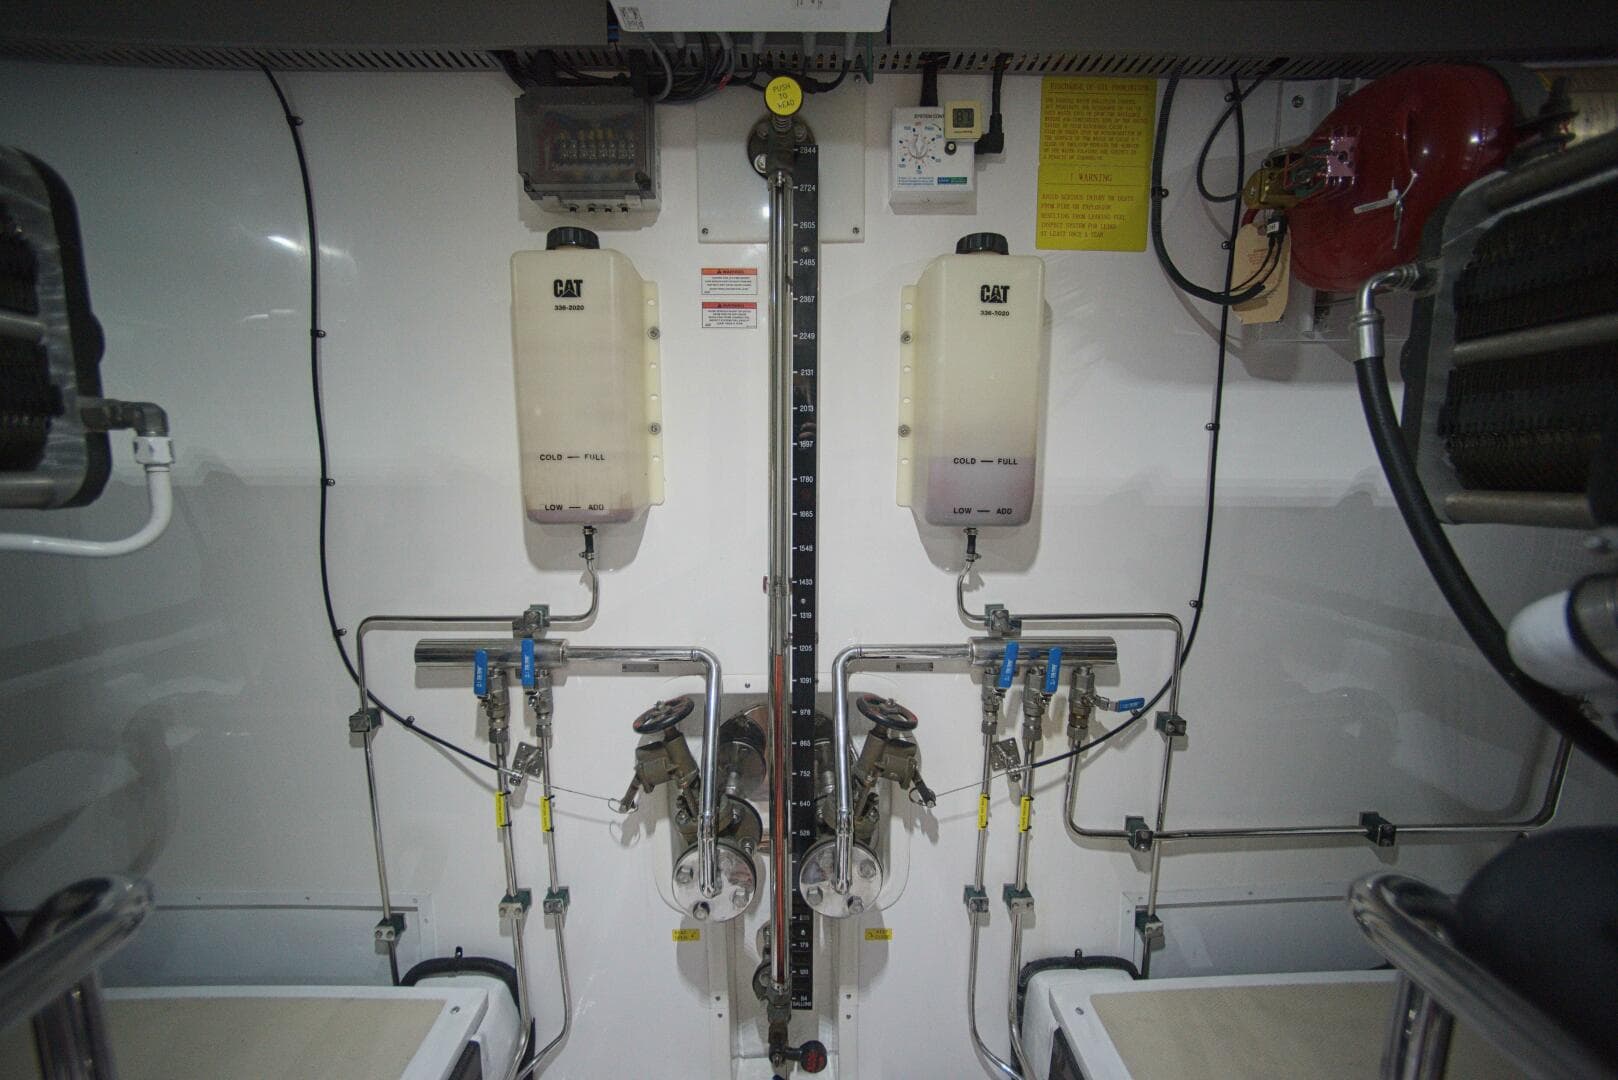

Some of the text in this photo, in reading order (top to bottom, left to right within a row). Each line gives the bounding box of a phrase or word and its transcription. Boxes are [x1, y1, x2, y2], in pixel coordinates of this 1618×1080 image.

[772, 82, 791, 93] PUSH
[777, 92, 788, 100] TO
[1079, 173, 1112, 182] WARNING
[800, 183, 816, 192] 2724
[800, 220, 816, 229] 2605
[553, 279, 583, 297] CAT
[980, 285, 1010, 303] CAT
